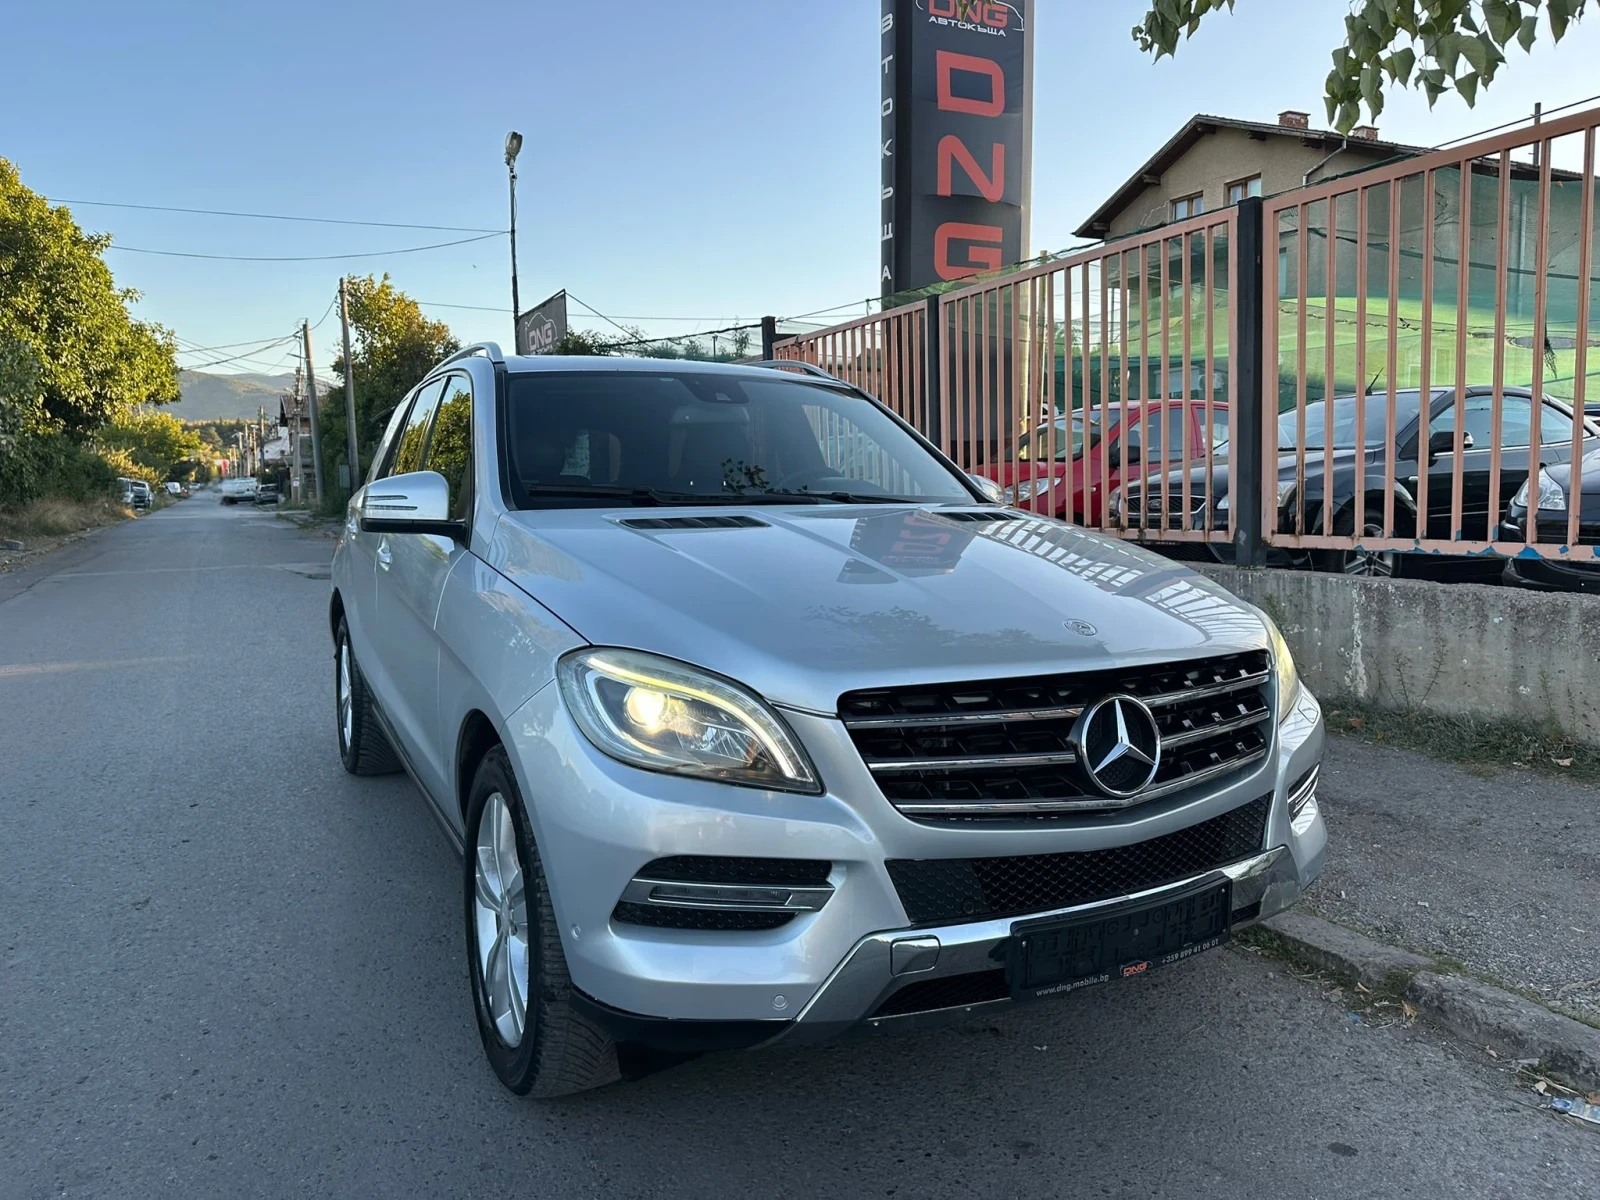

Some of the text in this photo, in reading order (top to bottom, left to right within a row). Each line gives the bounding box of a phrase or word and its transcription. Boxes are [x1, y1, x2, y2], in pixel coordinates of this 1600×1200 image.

[928, 16, 1006, 37] АВТОКЪЩА
[934, 50, 1005, 284] DNG
[529, 322, 553, 351] DNG
[1161, 952, 1179, 964] +359
[1036, 973, 1110, 997] www.dng.mobile.bg
